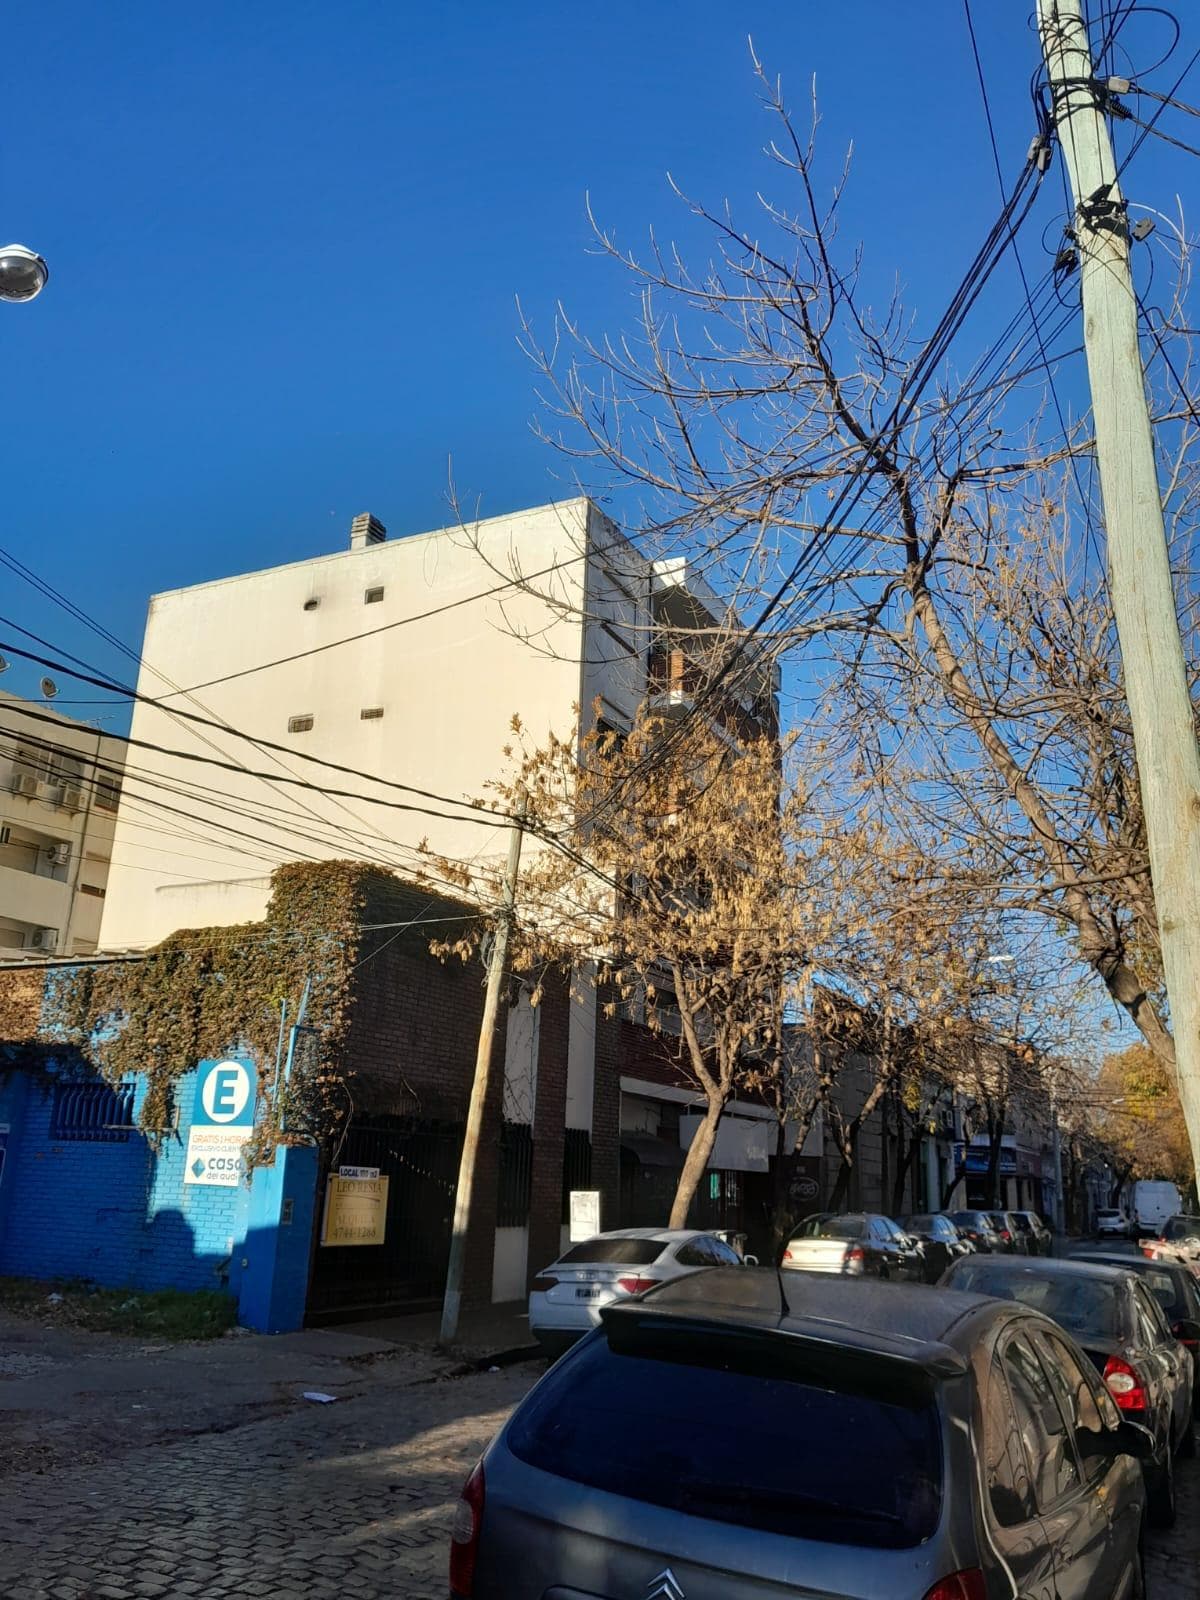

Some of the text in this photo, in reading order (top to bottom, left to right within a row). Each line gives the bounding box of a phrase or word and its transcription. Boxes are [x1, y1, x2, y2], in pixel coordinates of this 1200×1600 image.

[212, 1070, 239, 1114] E
[192, 1134, 219, 1144] GRATIS
[208, 1157, 241, 1171] casa
[206, 1171, 218, 1180] del
[340, 1168, 359, 1177] LOCAL
[337, 1181, 355, 1193] LEO
